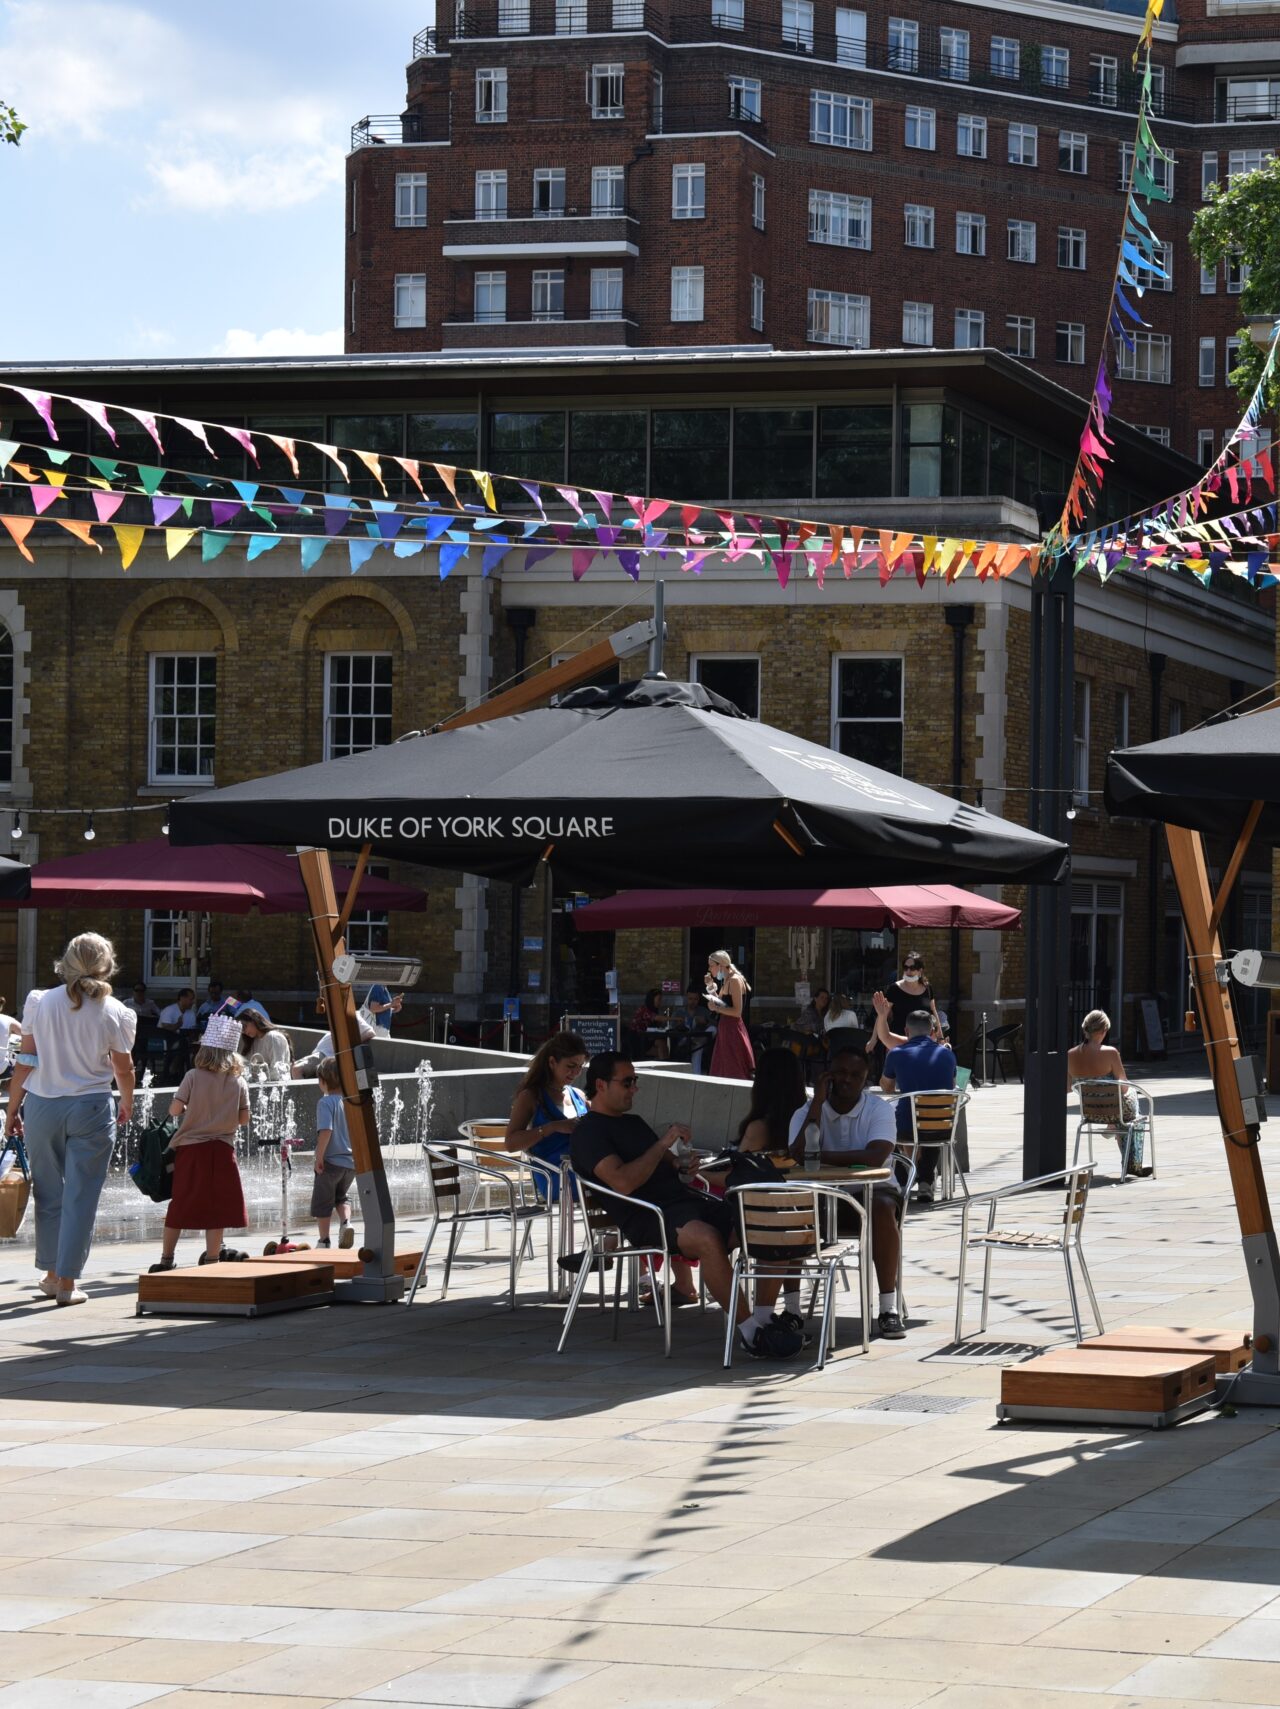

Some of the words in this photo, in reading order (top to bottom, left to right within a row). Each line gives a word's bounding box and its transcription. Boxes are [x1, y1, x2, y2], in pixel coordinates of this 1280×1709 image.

[328, 817, 393, 838] DUKE
[399, 817, 432, 838] OF
[437, 816, 504, 838] YORK
[511, 816, 616, 840] SQUARE
